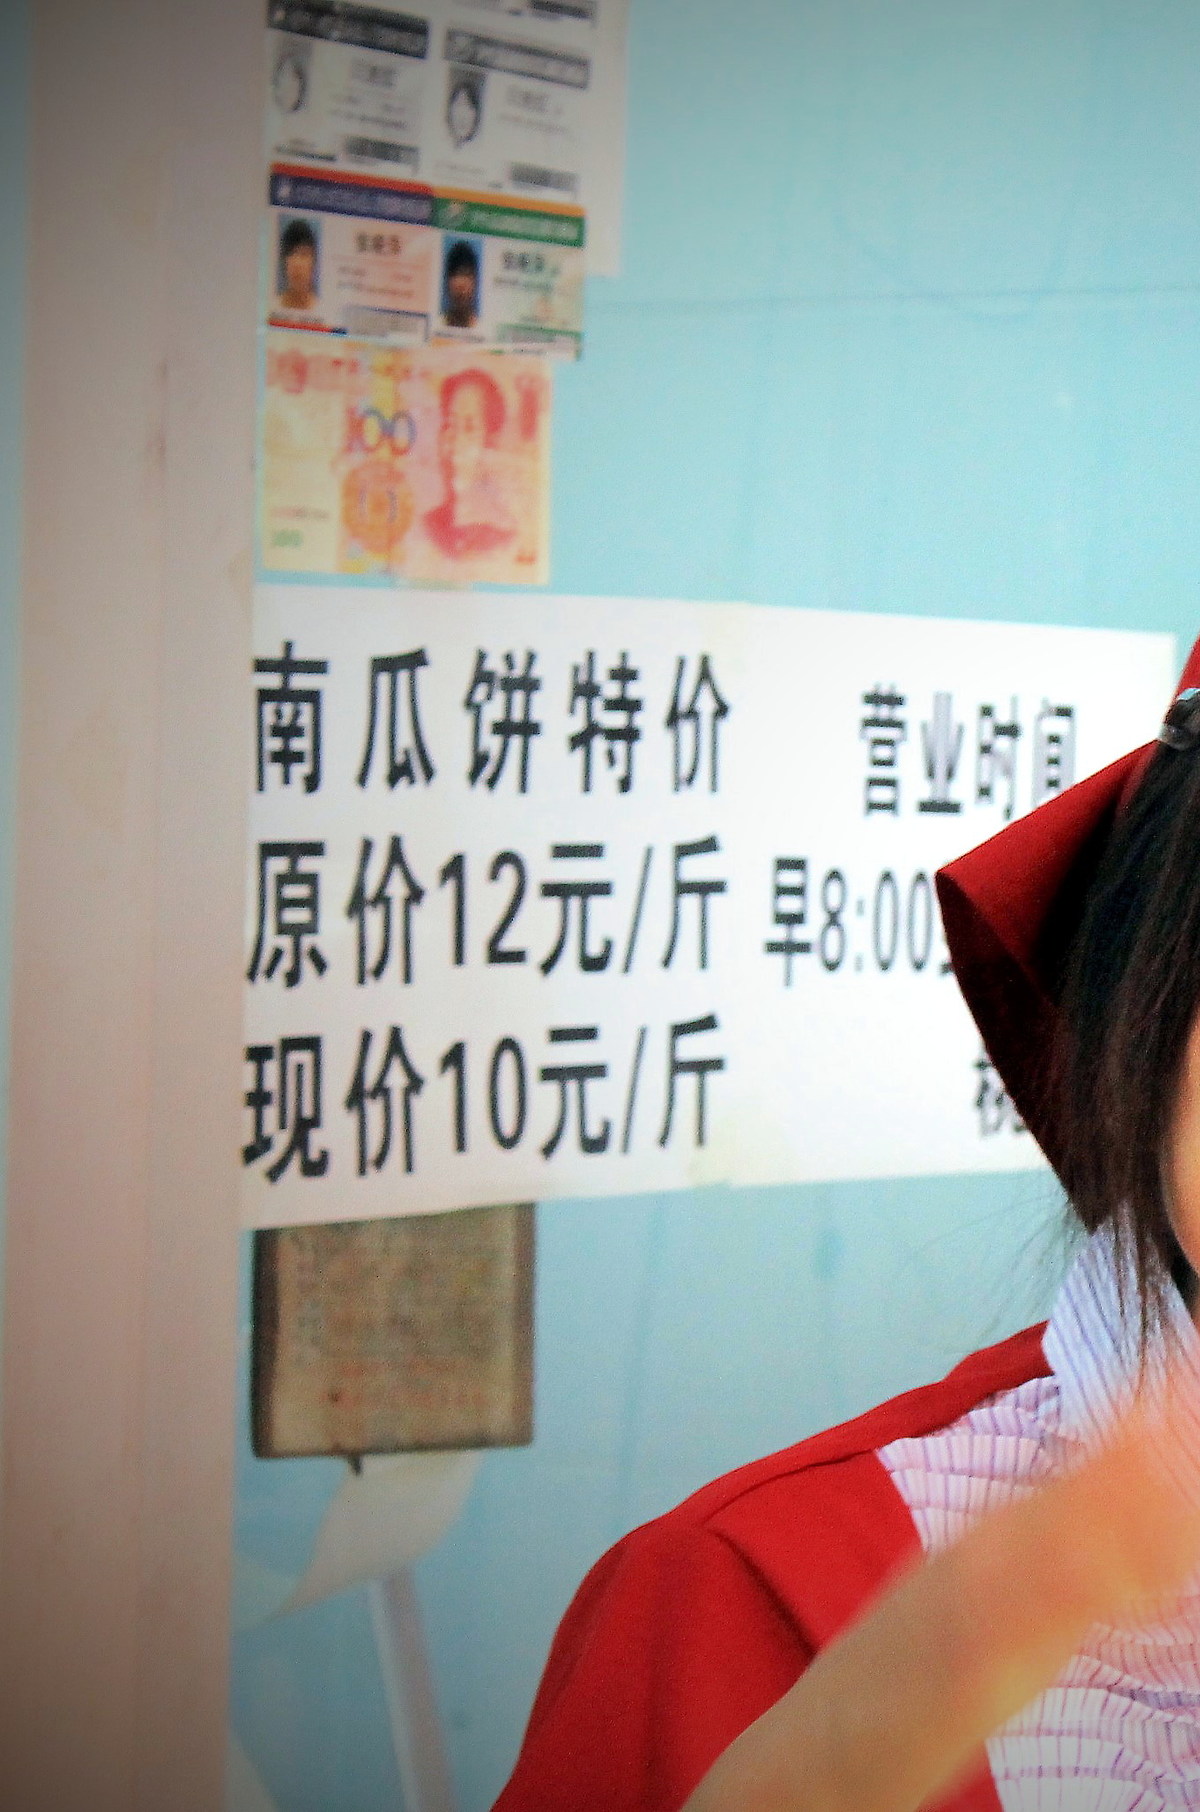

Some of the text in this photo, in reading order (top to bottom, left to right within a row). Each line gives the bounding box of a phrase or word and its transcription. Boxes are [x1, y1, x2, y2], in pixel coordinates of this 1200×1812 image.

[252, 640, 730, 794] 南瓜饼特价
[859, 682, 1075, 820] 营业时间
[246, 833, 728, 990] 原价12元/斤
[763, 856, 956, 989] 早8:00
[241, 1013, 726, 1186] 现价10元/斤
